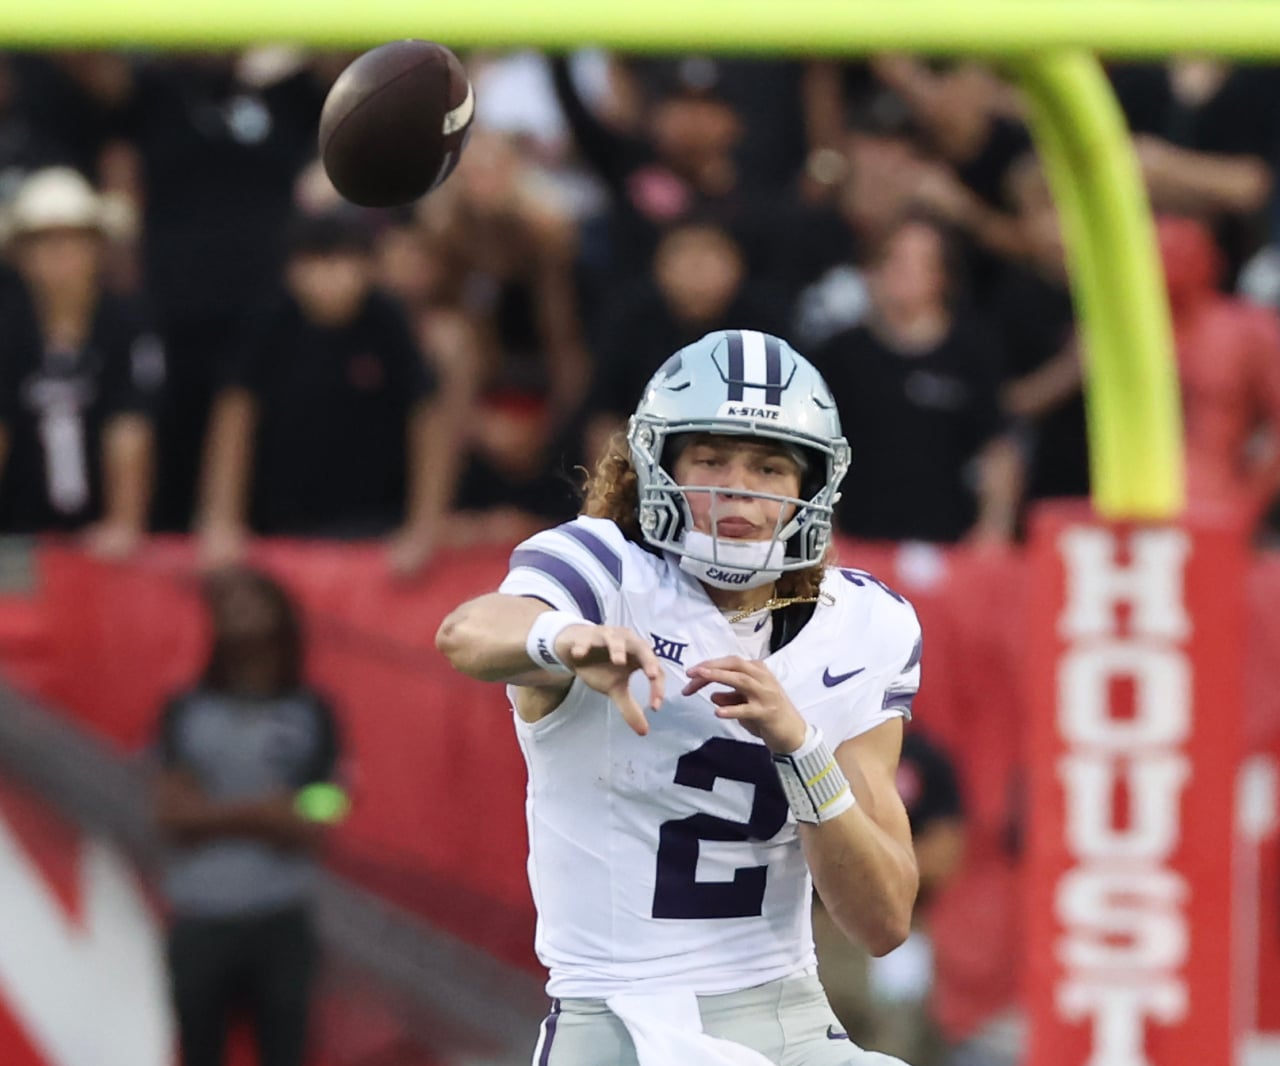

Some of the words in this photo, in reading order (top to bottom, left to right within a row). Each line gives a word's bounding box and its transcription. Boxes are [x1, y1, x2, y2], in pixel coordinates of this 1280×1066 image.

[727, 406, 780, 420] K-STATE
[705, 567, 757, 585] EMAW
[650, 632, 689, 666] XII
[652, 736, 790, 920] 2
